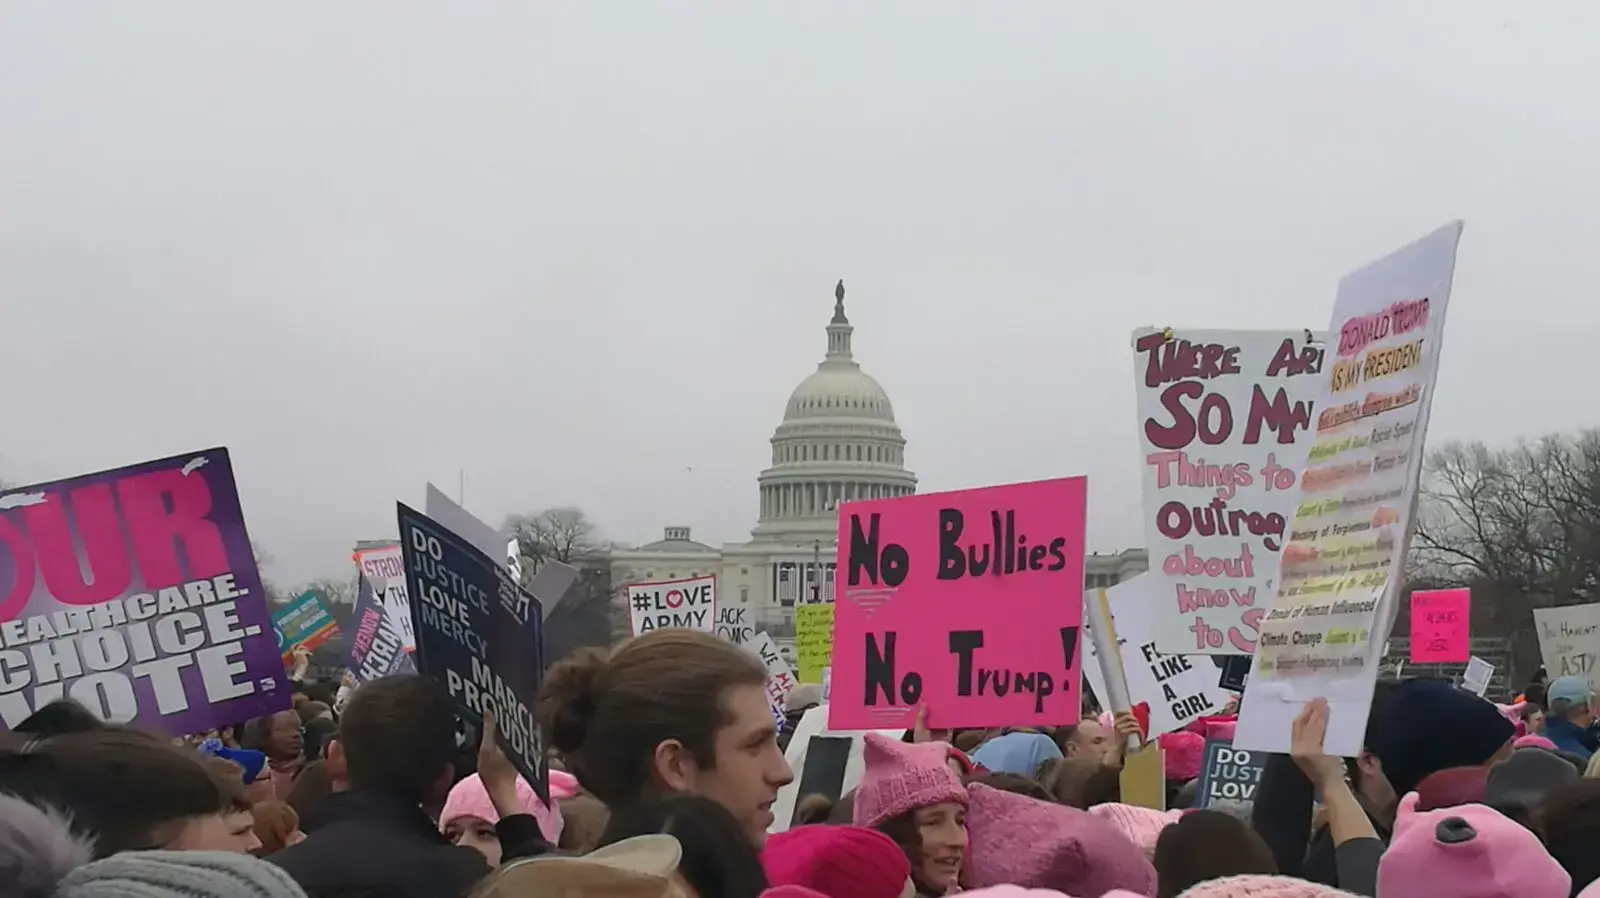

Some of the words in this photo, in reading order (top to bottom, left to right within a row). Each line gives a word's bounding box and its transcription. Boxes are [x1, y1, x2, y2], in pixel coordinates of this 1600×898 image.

[1337, 314, 1390, 356] DONALD
[1136, 332, 1241, 387] THERE
[1363, 338, 1424, 382] PRESIDENT
[1145, 380, 1233, 450] SO
[1147, 451, 1254, 501] Things
[1260, 452, 1297, 491] to
[411, 526, 442, 562] DO
[847, 513, 909, 587] No
[936, 508, 1066, 581] Bullies
[1162, 542, 1255, 578] about
[413, 552, 490, 615] JUSTICE
[418, 576, 469, 627] LOVE
[632, 584, 711, 612] #LOVE
[1176, 583, 1257, 614] know
[0, 573, 249, 650] EALTHCARE.
[640, 608, 707, 633] ARMY
[421, 606, 489, 660] MERCY
[1189, 616, 1225, 651] to
[1261, 632, 1289, 647] Climate
[1292, 630, 1322, 647] Change
[759, 641, 779, 666] WE
[864, 631, 922, 706] No
[1151, 653, 1193, 682] LIKE
[471, 655, 542, 752] MARCH
[1162, 683, 1178, 702] A
[1171, 691, 1214, 721] GIRL
[446, 668, 542, 780] PROUDLY
[1210, 764, 1264, 783] JUST
[1216, 749, 1251, 766] DO
[1211, 781, 1256, 799] LOV
